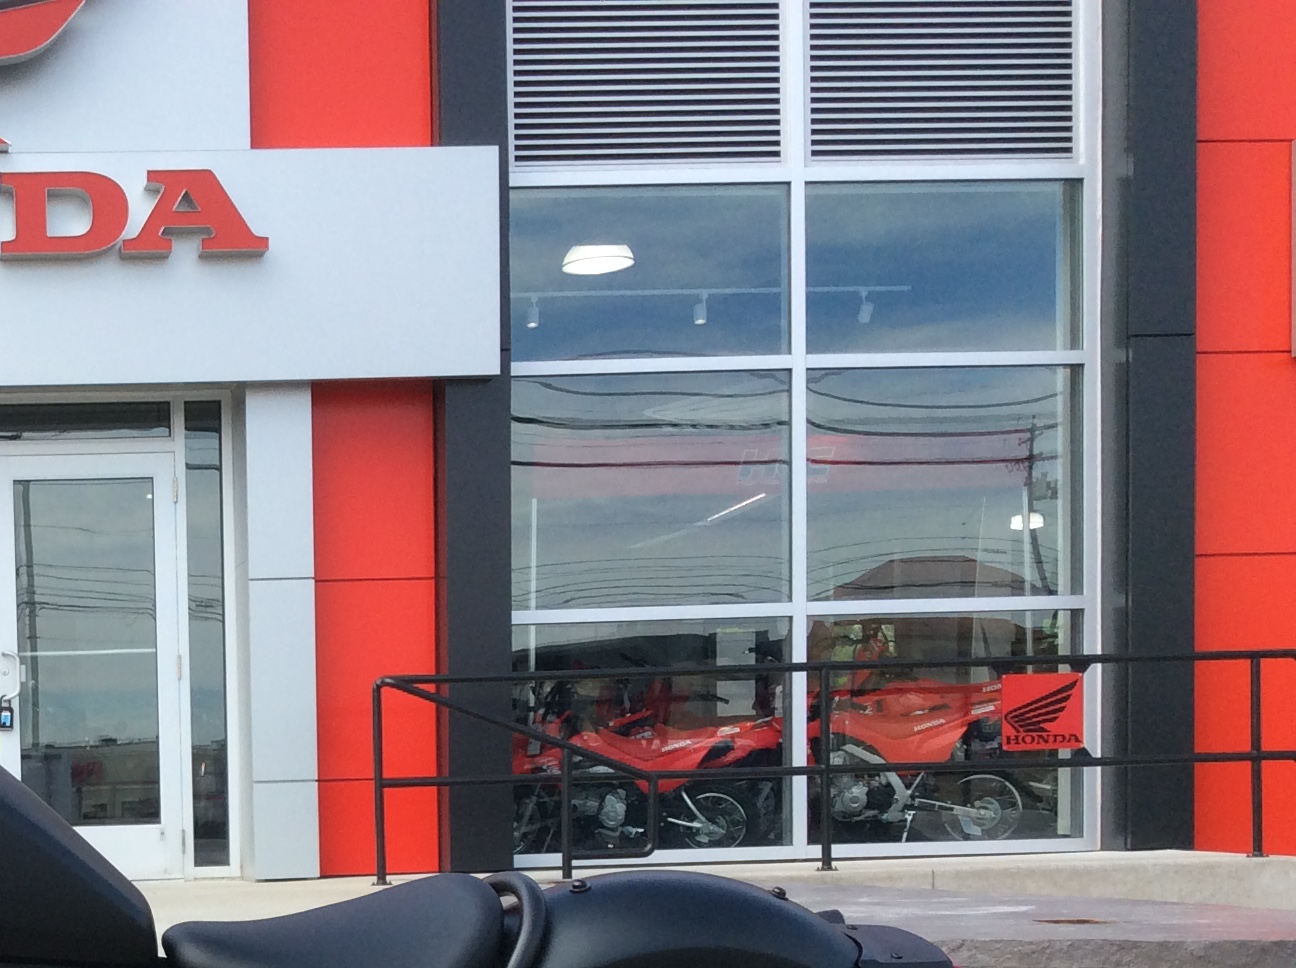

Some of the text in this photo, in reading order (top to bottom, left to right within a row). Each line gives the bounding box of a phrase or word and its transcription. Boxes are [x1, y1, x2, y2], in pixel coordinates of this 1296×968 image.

[913, 718, 946, 731] HONDA
[661, 739, 692, 752] HONDA
[1005, 733, 1082, 745] HONDA
